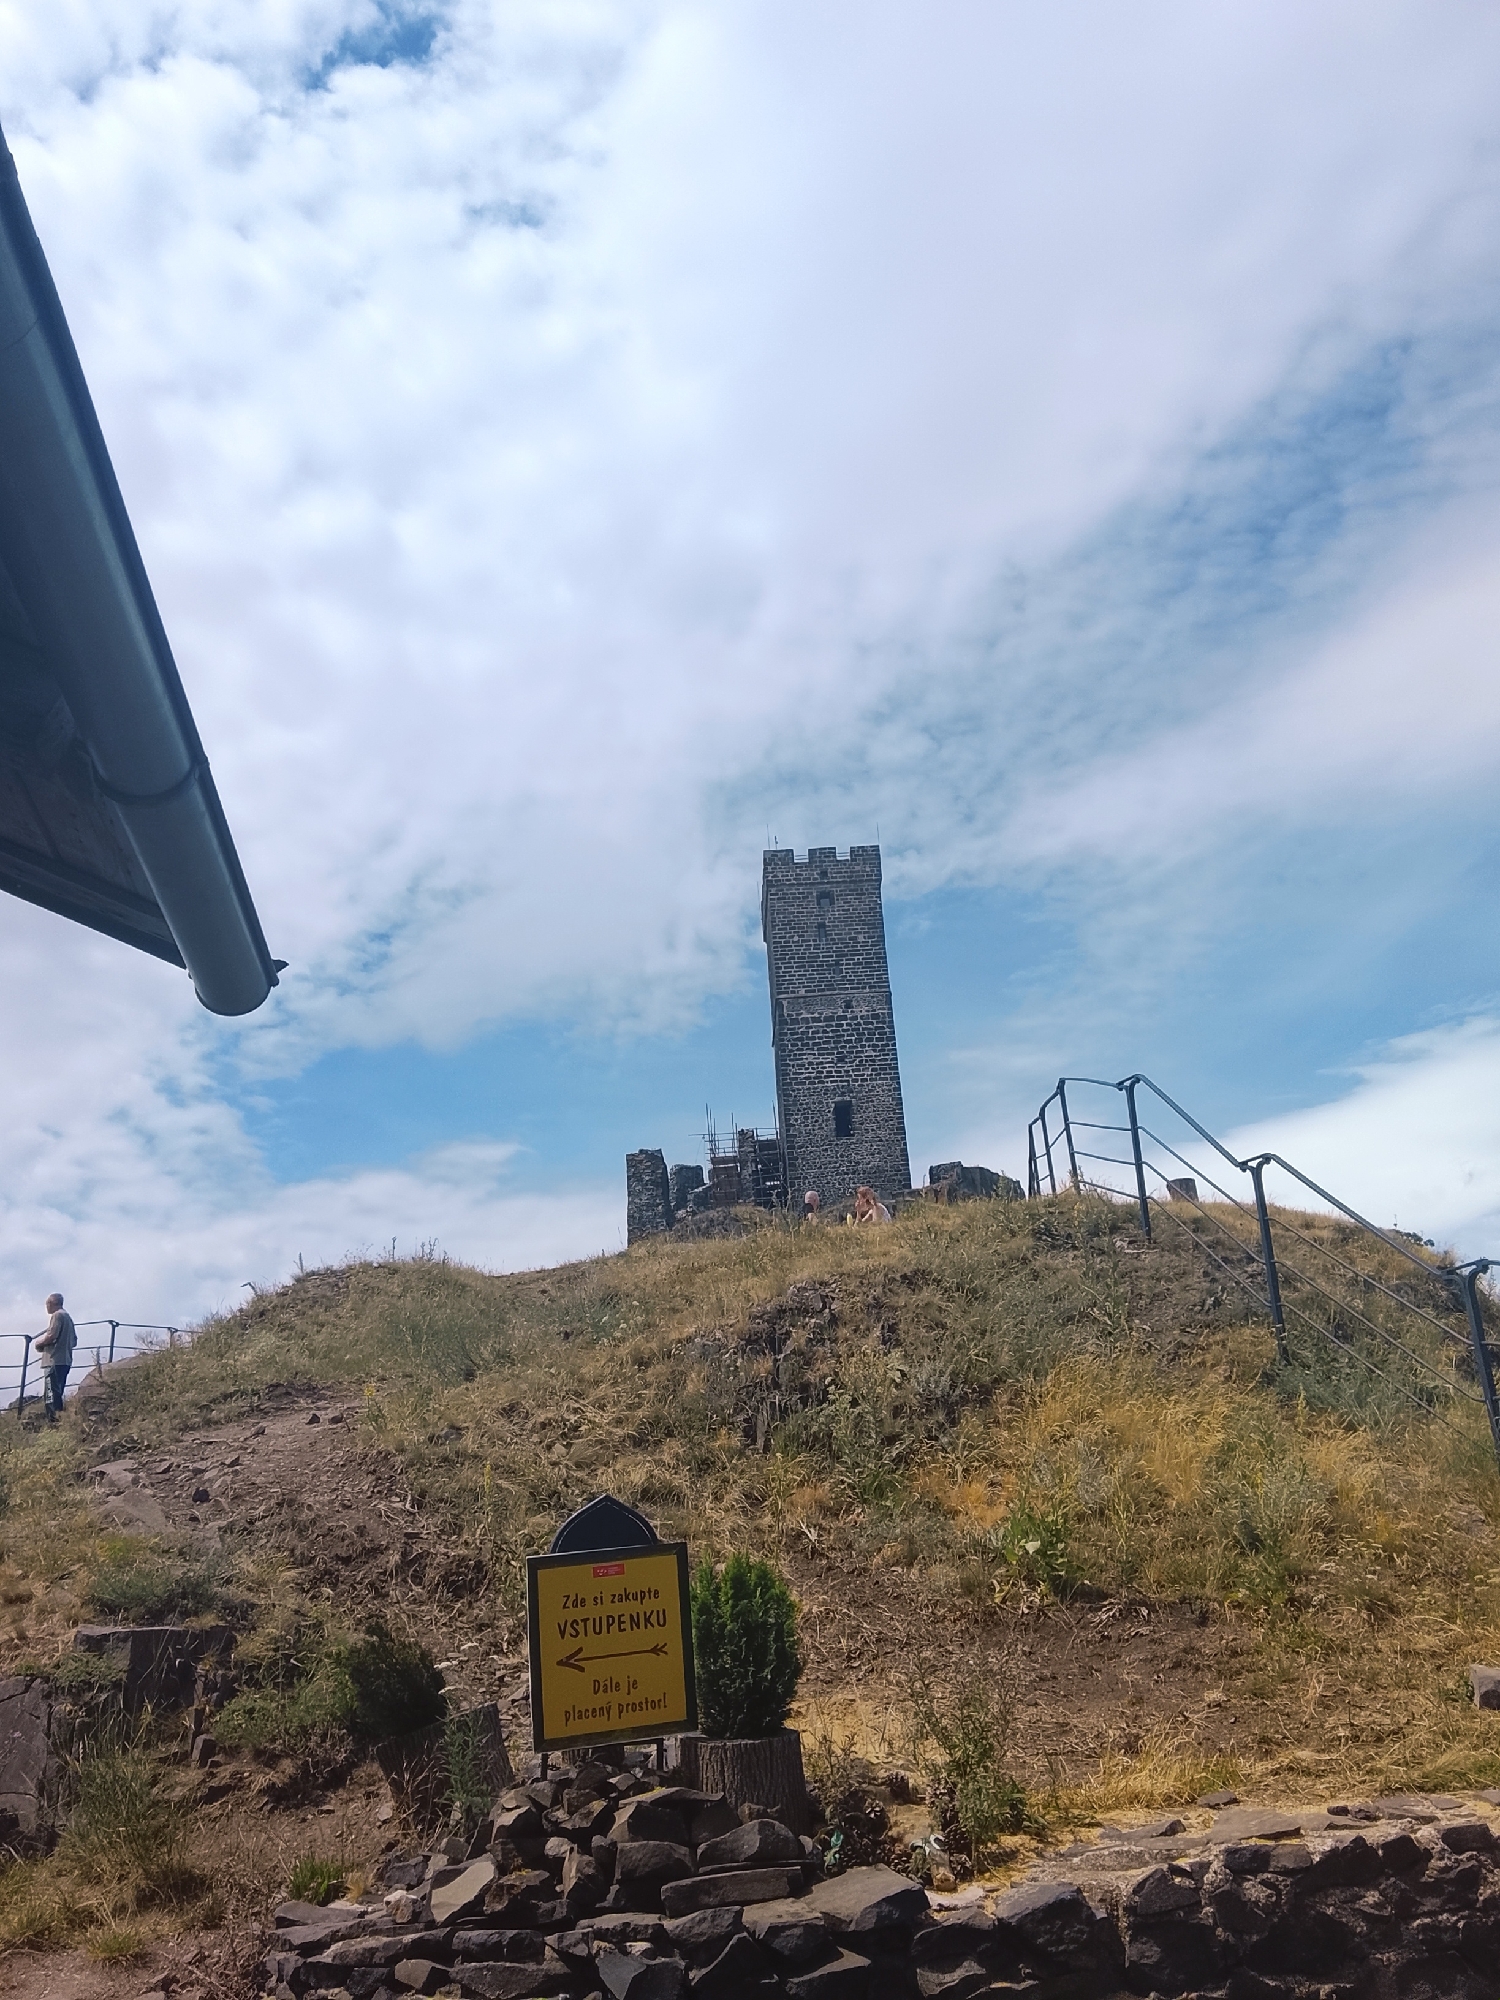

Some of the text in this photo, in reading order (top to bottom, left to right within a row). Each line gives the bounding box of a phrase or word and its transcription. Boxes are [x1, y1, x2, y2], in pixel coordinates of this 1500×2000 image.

[562, 1587, 660, 1609] Zde si zakupte
[557, 1609, 667, 1640] VSTUPENKU
[592, 1675, 639, 1695] Dále je
[564, 1692, 667, 1727] placený prostor!
